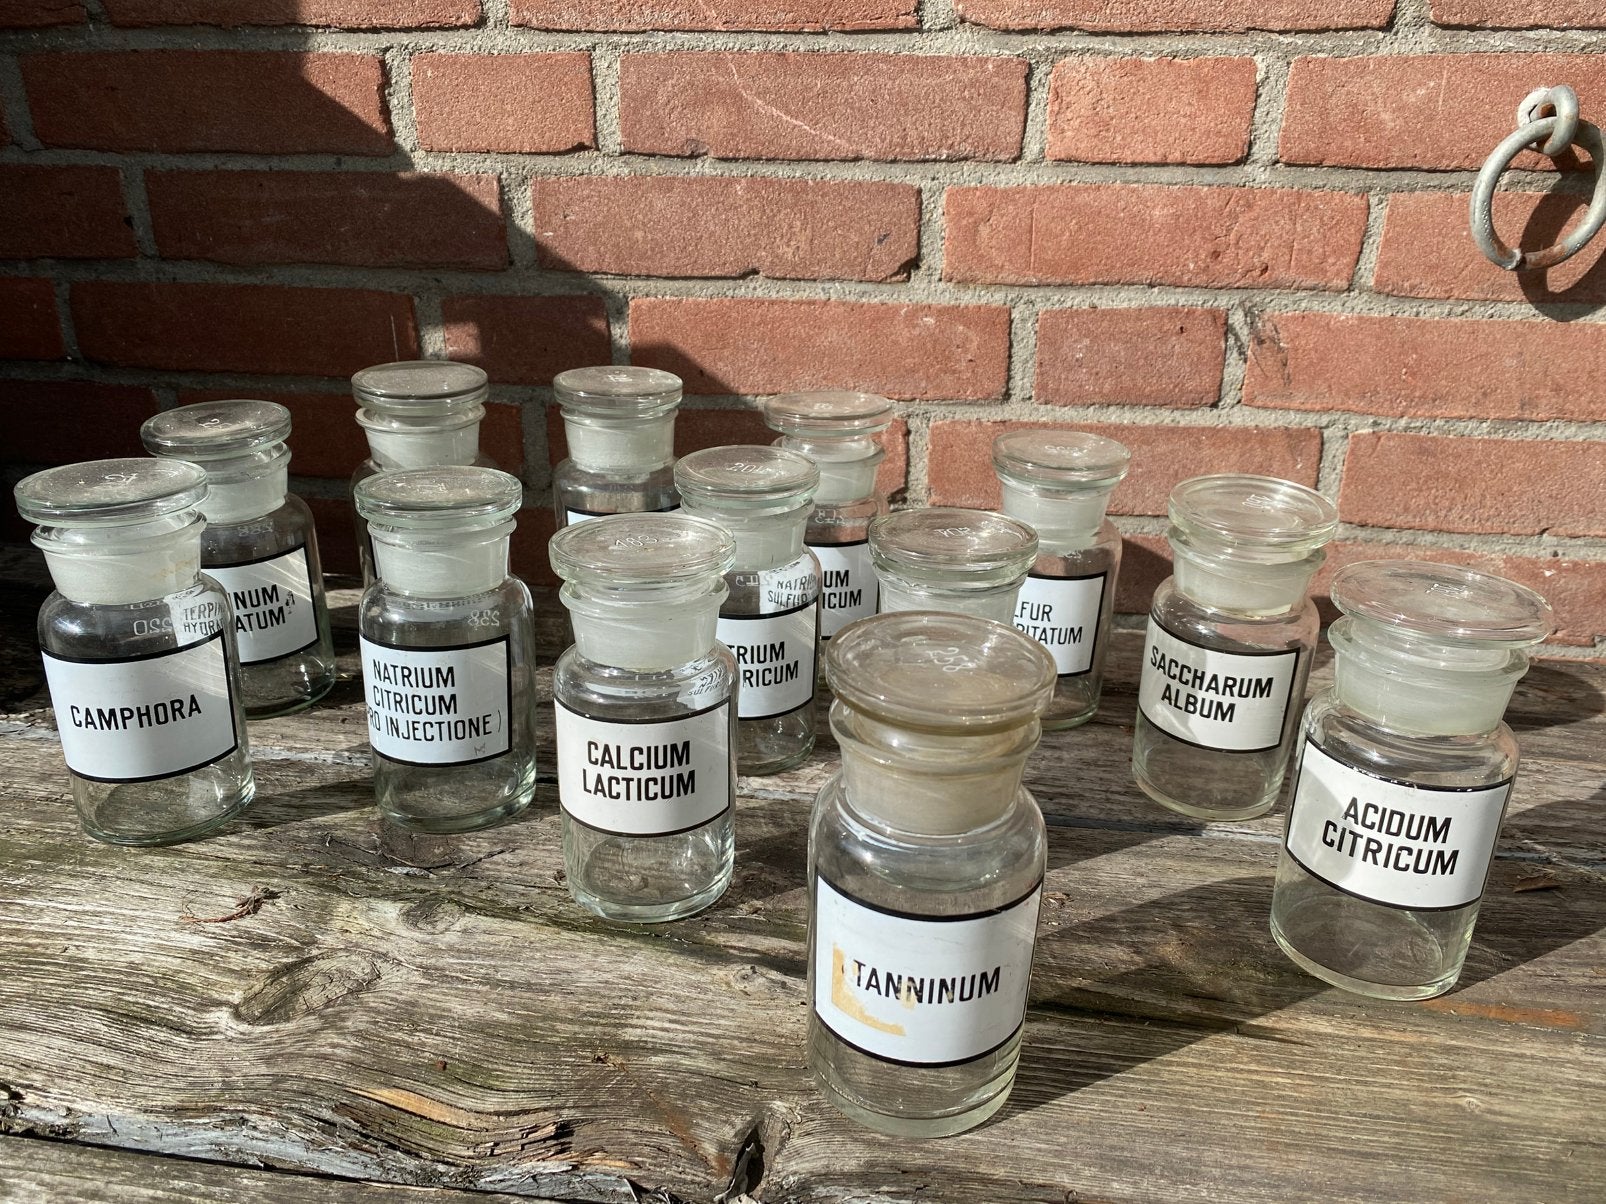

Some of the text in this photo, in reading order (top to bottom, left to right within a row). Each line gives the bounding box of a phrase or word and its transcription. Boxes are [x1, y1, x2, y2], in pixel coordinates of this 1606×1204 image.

[229, 584, 280, 611] NUM
[1014, 601, 1053, 622] FUR
[372, 658, 456, 688] NATRIUM
[1150, 645, 1274, 699] SACCHARUM
[70, 694, 202, 731] CAMPHORA
[373, 684, 458, 716] CITRICUM
[1160, 684, 1235, 723] ALBUM
[587, 740, 690, 771] CALCIUM
[582, 768, 696, 800] LACTICUM
[1343, 796, 1453, 844] ACIDUM
[1322, 819, 1459, 876] CITRICUM
[853, 958, 1001, 1006] TANNINUM
